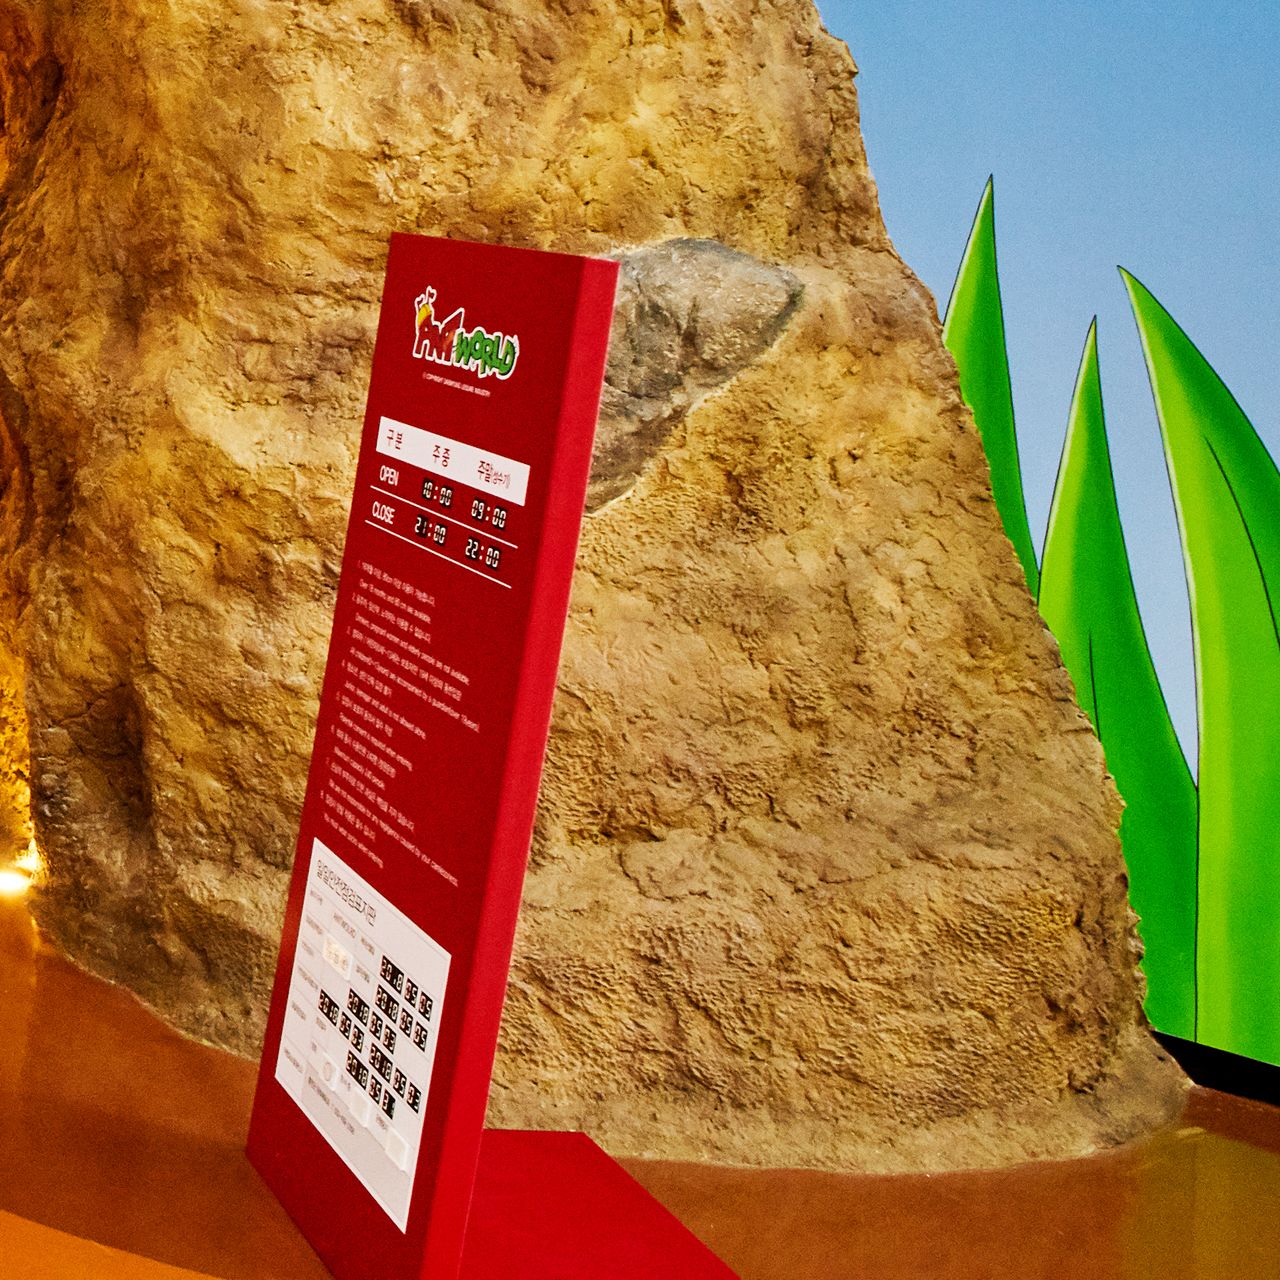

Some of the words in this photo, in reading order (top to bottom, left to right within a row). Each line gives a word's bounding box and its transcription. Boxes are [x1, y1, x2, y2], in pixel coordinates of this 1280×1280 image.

[414, 308, 464, 363] ANT
[454, 330, 516, 376] WORLD
[386, 428, 404, 451] 구분
[432, 444, 451, 468] 주중
[378, 464, 400, 487] OPEN
[422, 481, 453, 507] 10:00
[470, 499, 507, 529] 09:00
[371, 500, 397, 525] CLOSE
[414, 516, 447, 544] 21:00
[464, 538, 500, 568] 22:00
[347, 989, 369, 1025] 2018
[369, 1012, 382, 1039] 05
[382, 1025, 396, 1053] 03
[375, 986, 398, 1022] 2018
[399, 1010, 413, 1036] 05
[413, 1023, 427, 1051] 05
[404, 980, 418, 1006] 05
[418, 993, 432, 1020] 05
[318, 990, 339, 1025] 2018
[339, 1012, 351, 1038] 05
[368, 1043, 392, 1082] 2018
[392, 1068, 406, 1097] 05
[345, 1051, 368, 1089] 2018
[368, 1076, 381, 1103] 05
